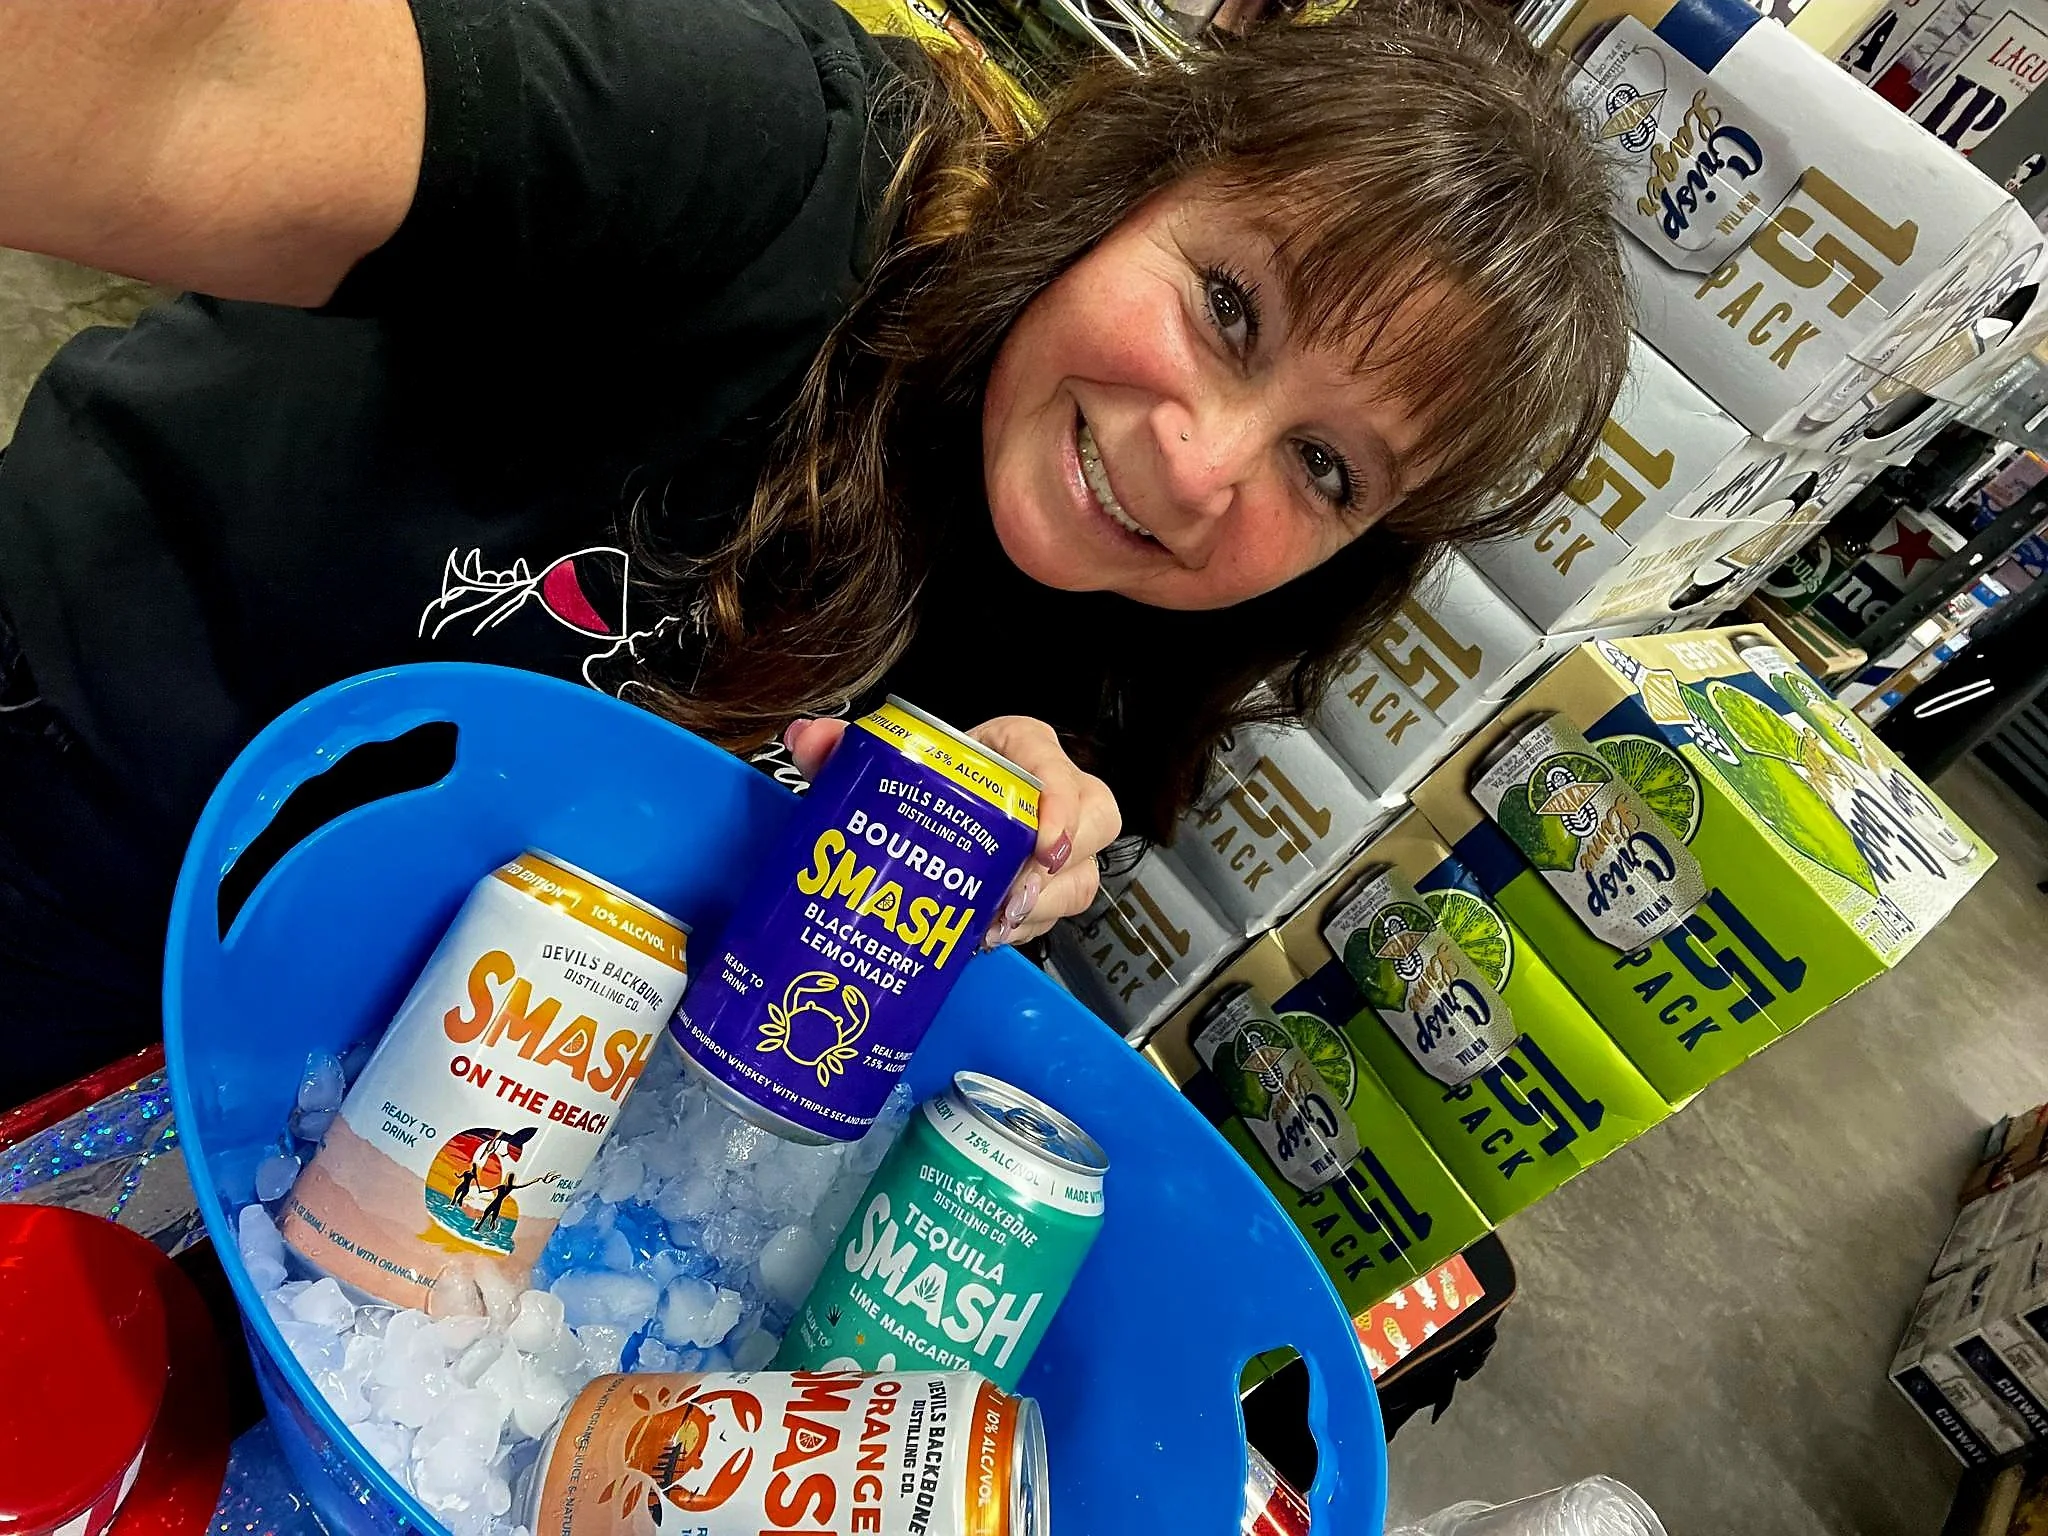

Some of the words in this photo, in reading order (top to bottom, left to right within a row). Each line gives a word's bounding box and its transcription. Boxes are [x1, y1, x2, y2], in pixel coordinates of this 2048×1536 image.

[1637, 88, 1721, 217] Lager
[1661, 126, 1763, 240] Crisp
[1715, 210, 1744, 236] TRAIL
[1736, 190, 1761, 216] NEW
[1749, 166, 1919, 320] 15
[1694, 261, 1821, 370] PACK
[1370, 598, 1483, 711] 15
[1664, 638, 1736, 671] LAGER
[924, 745, 952, 766] 7.5%
[954, 763, 1006, 798] ALC/VOL
[1225, 755, 1332, 865] 15
[845, 809, 983, 901] BOURBON
[879, 778, 932, 807] DEVILS
[933, 798, 999, 856] BACKBONE
[897, 801, 955, 843] DISTILLING
[956, 836, 972, 853] CO.
[1199, 808, 1274, 892] PACK
[1579, 793, 1640, 872] Lime
[1850, 788, 1947, 884] Crisp
[518, 869, 565, 898] EDITION
[591, 905, 619, 927] 10%
[619, 920, 666, 952] ALC/VOL
[796, 828, 976, 970] SMASH
[1586, 831, 1675, 917] Crisp
[1655, 894, 1673, 914] NEW
[803, 902, 925, 979] BLACKBERRY
[1104, 878, 1191, 980] 15
[1632, 907, 1657, 928] TRAIL
[1663, 886, 1807, 1024] 15
[542, 944, 600, 971] DEVILS
[602, 960, 664, 1012] BACKBONE
[563, 968, 625, 1005] DISTILLING
[624, 997, 640, 1013] CO.
[720, 968, 750, 997] DRINK
[723, 951, 751, 980] READY
[748, 972, 765, 989] TO
[800, 926, 908, 996] LEMONADE
[1613, 947, 1722, 1052] PACK
[443, 950, 653, 1108] SMASH
[871, 1043, 894, 1060] REAL
[1414, 978, 1491, 1054] Crisp
[449, 1055, 493, 1089] ON
[499, 1075, 543, 1116] THE
[553, 1101, 610, 1137] BEACH
[691, 1025, 728, 1060] BOURBON
[727, 1053, 772, 1088] WHISKEY
[771, 1081, 800, 1103] WITH
[799, 1096, 831, 1117] TRIPLE
[829, 1109, 846, 1121] SEC
[862, 1055, 883, 1070] 7.5%
[1482, 1033, 1606, 1157] 15
[381, 1101, 419, 1130] READY
[418, 1122, 437, 1140] TO
[381, 1123, 418, 1149] DRINK
[1276, 1092, 1339, 1162] Crisp
[1441, 1083, 1536, 1181] PACK
[964, 1131, 989, 1154] 7.5%
[989, 1150, 1040, 1186] ALC/VOL
[1064, 1186, 1090, 1204] MADE
[1345, 1146, 1434, 1265] 15
[904, 1202, 1006, 1286] TEQUILA
[919, 1164, 966, 1198] DEVILS
[965, 1183, 1039, 1250] BACKBONE
[932, 1191, 989, 1237] DISTILLING
[989, 1226, 1008, 1248] CO.
[1298, 1190, 1376, 1283] PACK
[328, 1229, 355, 1253] VODKA
[355, 1246, 378, 1265] WITH
[845, 1192, 1044, 1369] SMASH
[849, 1282, 881, 1320] LIME
[879, 1313, 972, 1372] MARGARITA
[578, 1411, 602, 1451] ORANGE
[903, 1400, 927, 1468] DISTILLING
[927, 1380, 947, 1423] DEVILS
[986, 1409, 1001, 1434] 10%
[570, 1453, 584, 1482] JUICE
[764, 1371, 864, 1536] SMAS
[851, 1381, 903, 1533] ORANGE
[900, 1472, 915, 1499] CO.
[908, 1426, 946, 1536] BACKBONE
[978, 1436, 997, 1507] ALC/VOL
